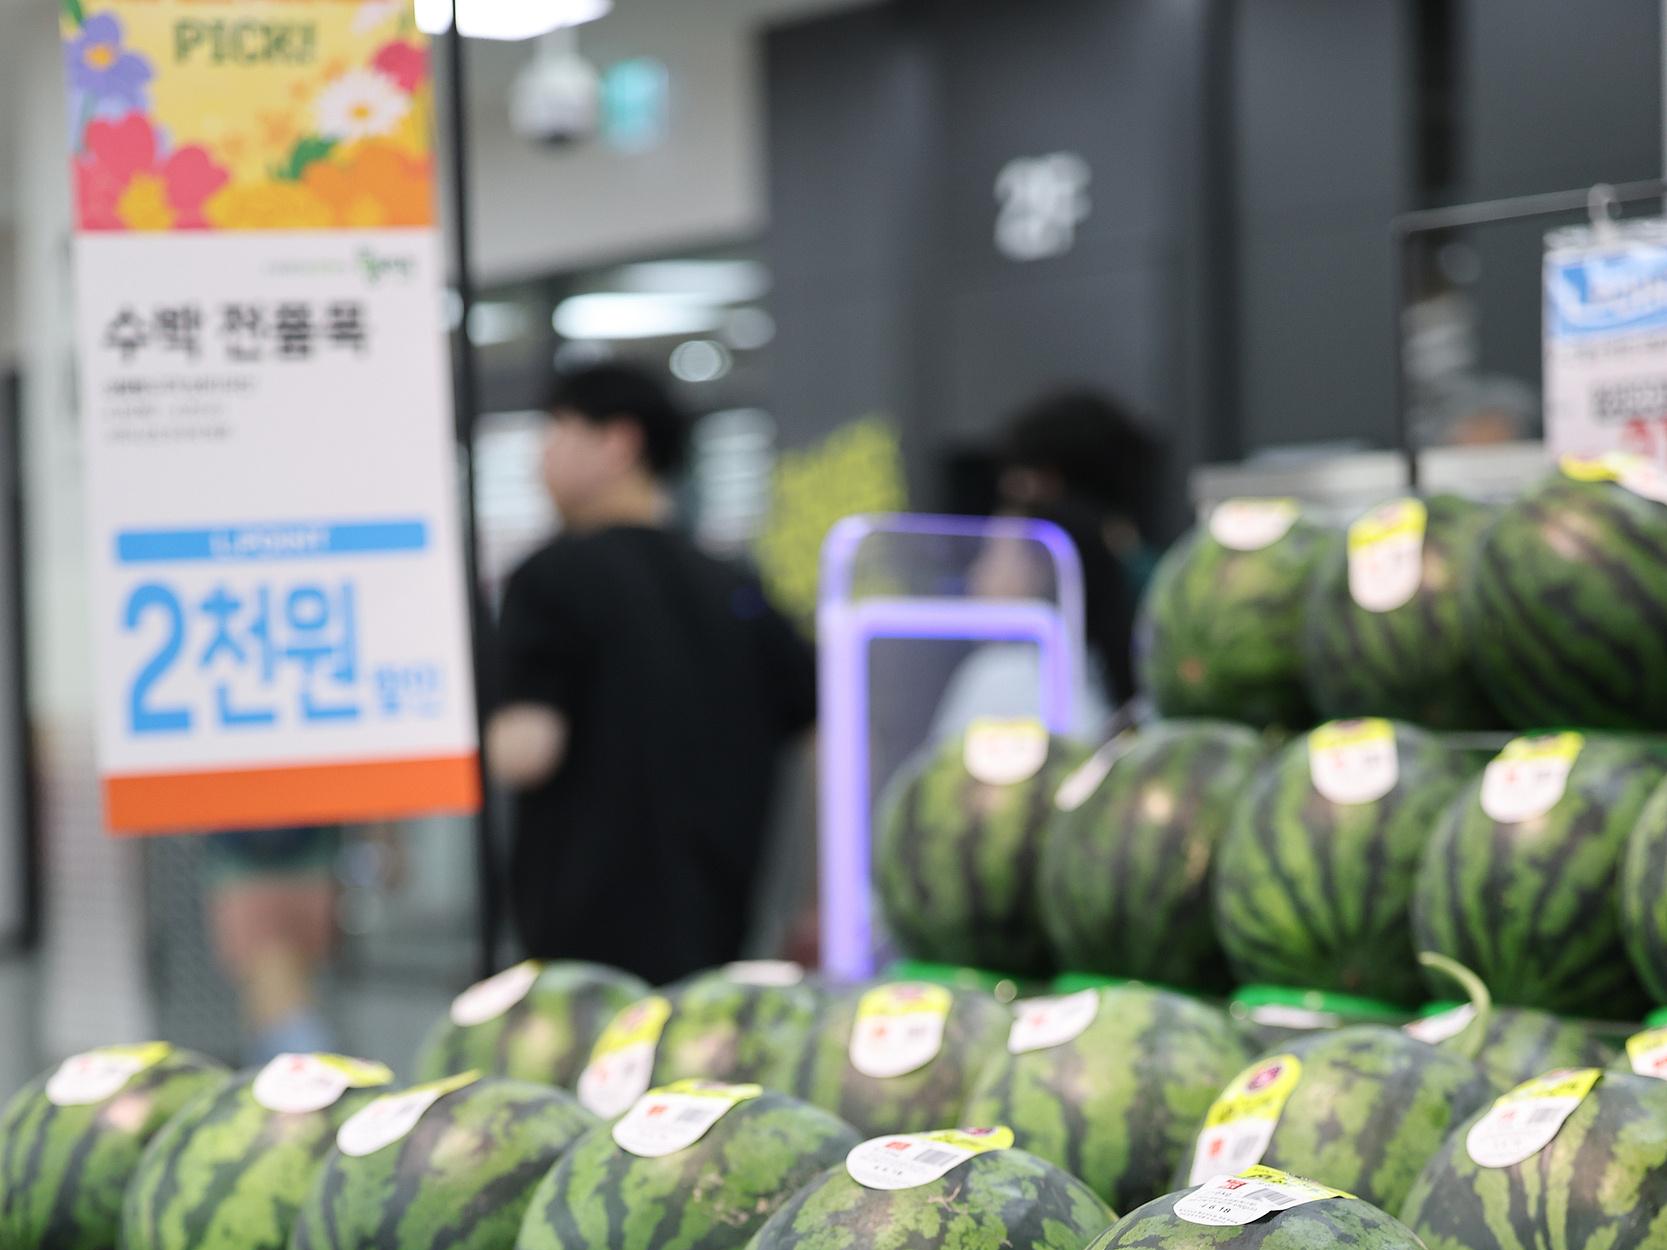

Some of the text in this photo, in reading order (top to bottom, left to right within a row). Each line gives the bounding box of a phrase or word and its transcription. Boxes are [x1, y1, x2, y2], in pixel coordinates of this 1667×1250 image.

[172, 19, 317, 64] PICK!
[105, 303, 203, 362] 수박
[122, 580, 361, 735] 2천원
